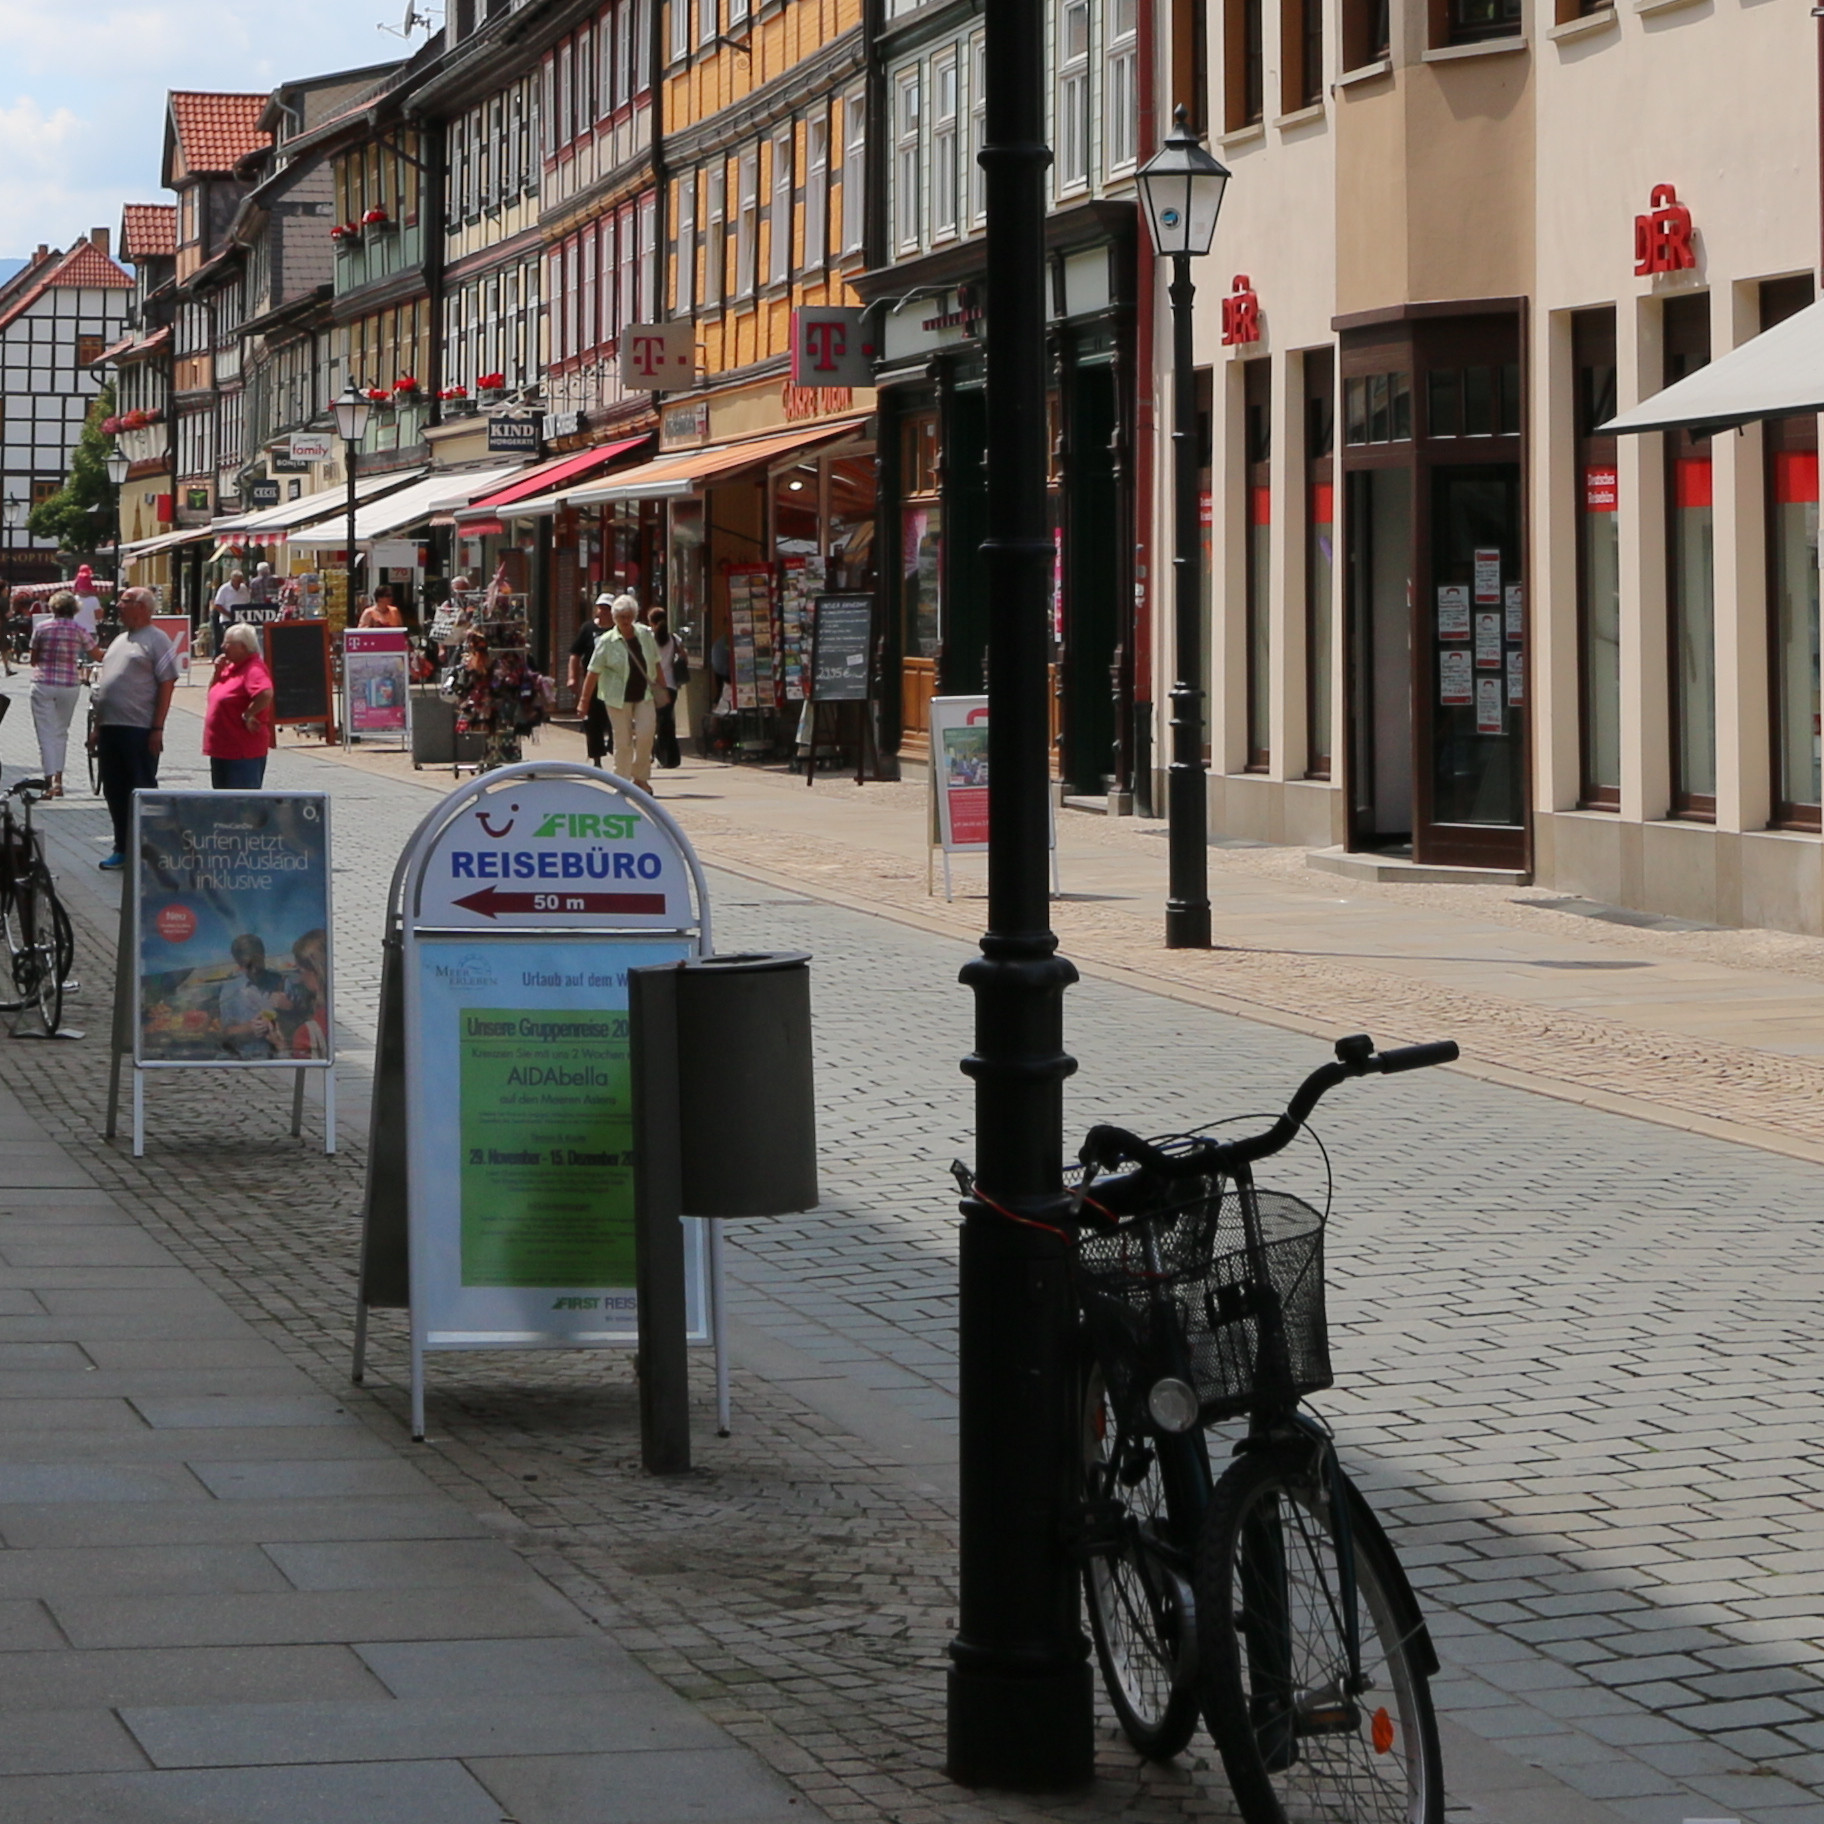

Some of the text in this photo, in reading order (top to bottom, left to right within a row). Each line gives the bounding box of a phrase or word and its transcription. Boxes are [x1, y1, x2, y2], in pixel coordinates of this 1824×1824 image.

[1635, 206, 1695, 276] DER
[1221, 291, 1259, 346] DER
[491, 424, 534, 436] KIND
[293, 444, 328, 457] family
[234, 610, 276, 622] KIND
[532, 813, 641, 839] FIRST
[182, 830, 284, 855] Surfen jetzt
[158, 850, 308, 870] auch im Ausland
[451, 846, 662, 879] REISEBÜRO
[196, 870, 272, 890] inklusive
[534, 895, 584, 910] 50 m
[522, 972, 561, 987] Urlaub
[565, 972, 583, 987] auf
[588, 972, 612, 987] dem
[467, 1017, 517, 1037] Unsere
[507, 1064, 608, 1086] AIDAbella
